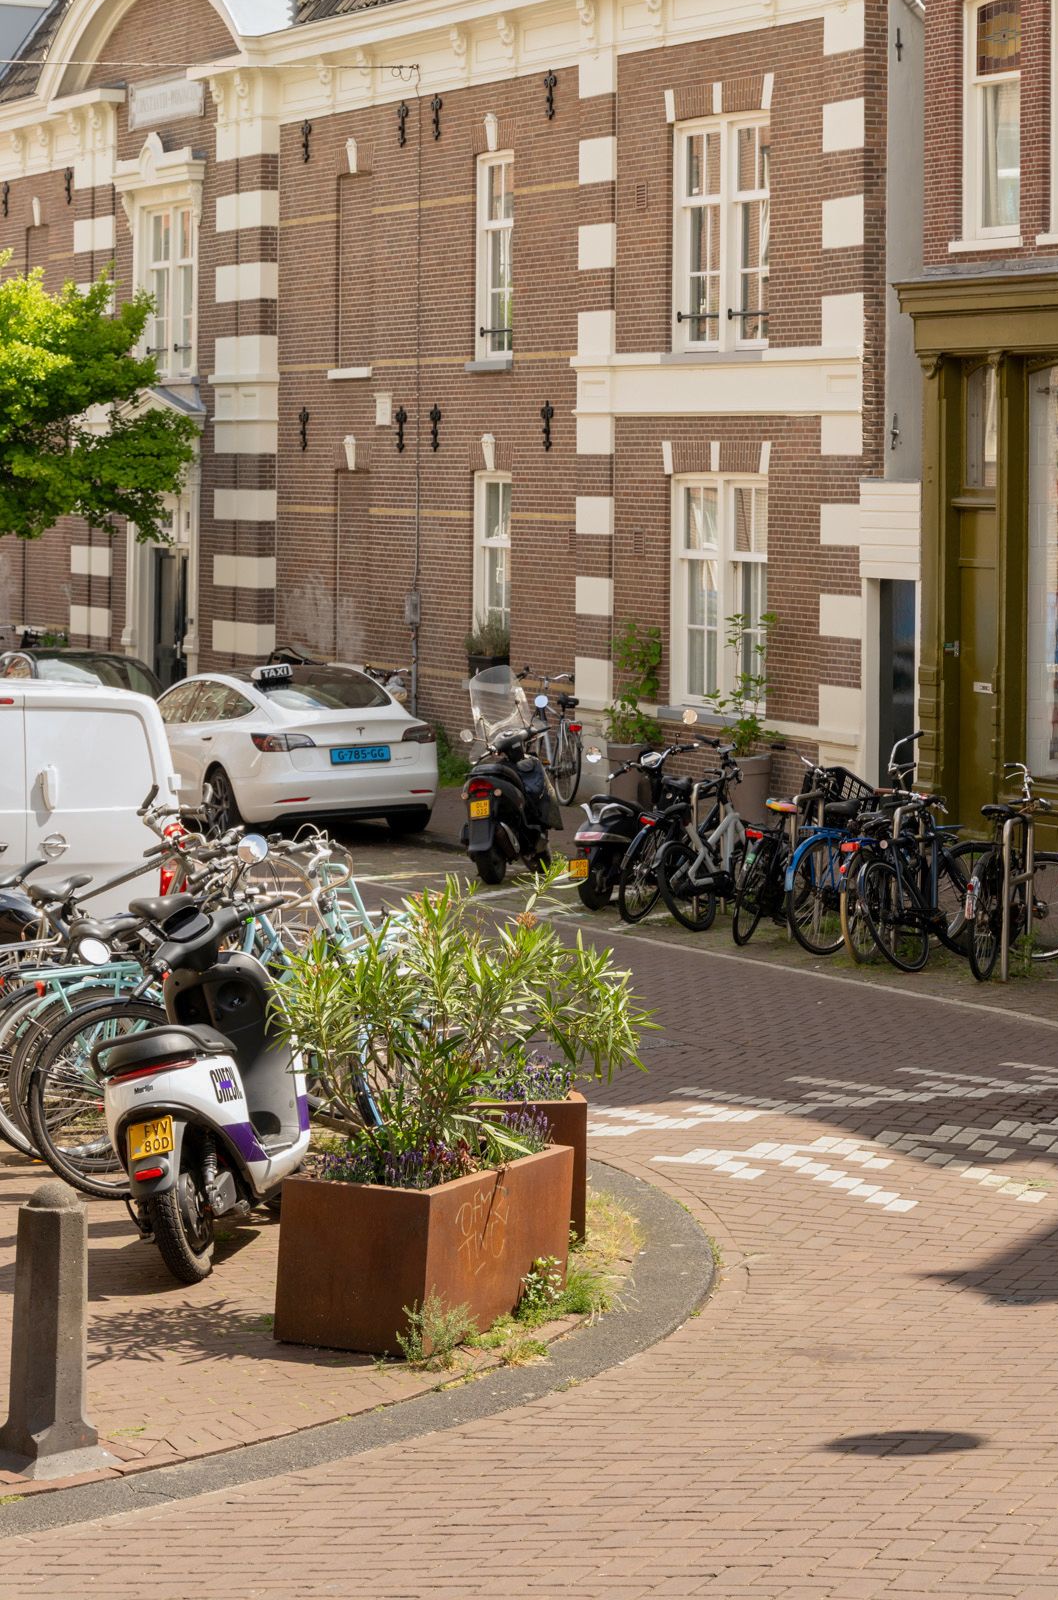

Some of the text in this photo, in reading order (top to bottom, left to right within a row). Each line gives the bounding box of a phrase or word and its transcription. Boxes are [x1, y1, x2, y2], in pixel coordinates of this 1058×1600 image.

[263, 666, 288, 678] TAXI
[338, 749, 385, 761] G-785-GG
[144, 1120, 168, 1134] FVV
[144, 1136, 170, 1152] 80D
